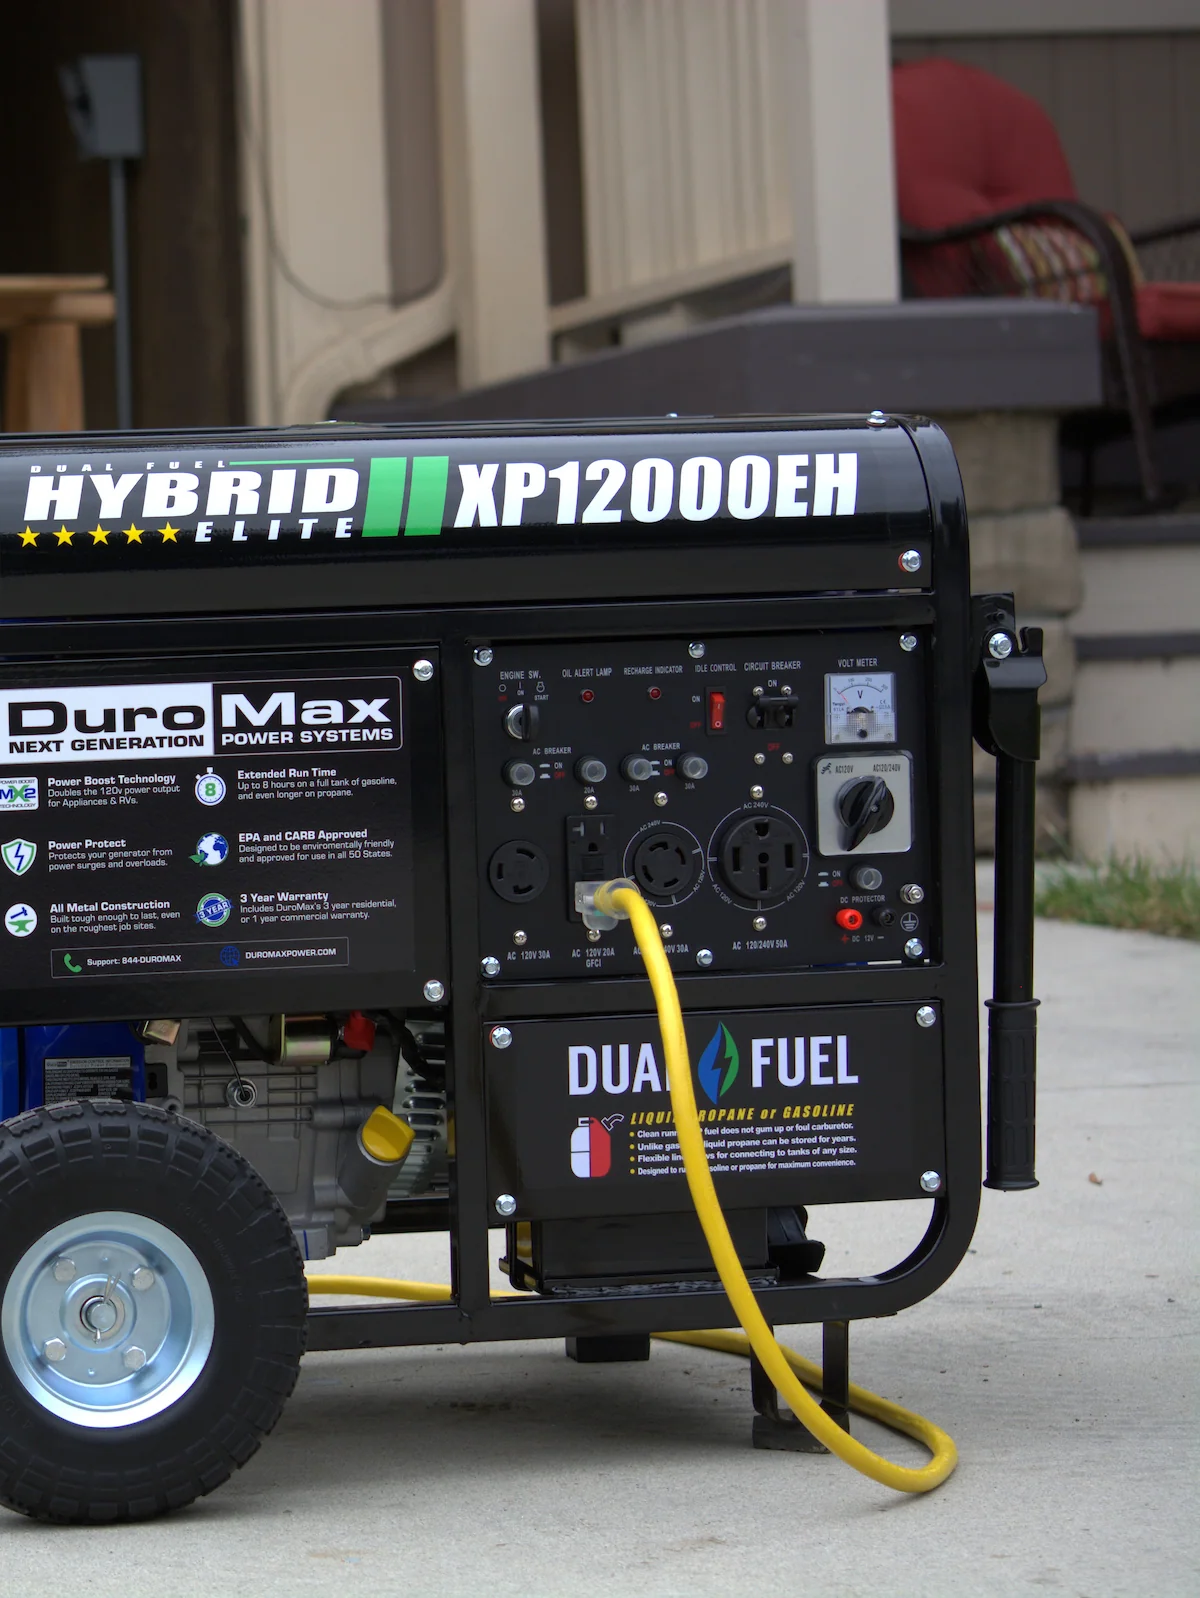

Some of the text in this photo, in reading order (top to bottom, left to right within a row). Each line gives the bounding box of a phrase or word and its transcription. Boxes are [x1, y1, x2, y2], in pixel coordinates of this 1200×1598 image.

[30, 460, 226, 473] DUAL FUEL
[23, 452, 858, 528] HYBRID XP12000EH
[194, 517, 354, 542] ELITE
[695, 663, 737, 673] IDLE CONTROL
[744, 661, 801, 671] CIRCUIT BREAKER
[838, 658, 878, 668] VOLT METER
[500, 670, 541, 680] ENGINE SW.
[562, 668, 612, 678] OIL ALERT LAMP
[624, 665, 683, 676] RECHARGE INDICATOR
[768, 680, 777, 688] ON
[8, 728, 393, 754] NEXT GENERATION POWER SYSTEMS
[544, 747, 571, 755] BREAKER
[237, 768, 336, 779] Extended Run Time
[48, 774, 176, 787] Power Boost Technology
[237, 782, 250, 791] Up
[262, 780, 269, 789] 8
[316, 779, 329, 787] full
[331, 778, 350, 786] tank
[351, 777, 359, 786] of
[48, 788, 82, 797] Doubles
[124, 787, 151, 796] power
[152, 785, 180, 794] output
[205, 783, 216, 796] 8
[238, 792, 253, 800] and
[277, 791, 303, 800] longer
[48, 796, 138, 808] for Appliances & RVs.
[239, 829, 367, 842] EPA and CARB Approved
[48, 839, 126, 850] Power Protect
[238, 844, 277, 854] Designed
[364, 839, 394, 849] friendly
[48, 848, 173, 861] Protects your generator from
[239, 854, 254, 863] and
[256, 853, 295, 863] approved
[297, 852, 309, 860] for
[337, 851, 346, 859] all
[349, 850, 361, 858] 50
[48, 863, 75, 872] power
[77, 862, 106, 871] surges
[108, 860, 123, 868] and
[240, 892, 329, 904] 3 Year Warranty
[852, 894, 885, 903] PROTECTOR
[50, 900, 170, 913] All Metal Construction
[206, 902, 228, 914] YEAR
[240, 905, 274, 913] Includes
[323, 901, 329, 910] 3
[331, 903, 350, 911] year
[50, 915, 70, 923] Built
[71, 914, 96, 924] tough
[98, 913, 128, 922] enough
[260, 916, 278, 924] year
[280, 912, 328, 921] commercial
[63, 925, 77, 933] the
[79, 924, 117, 933] roughest
[119, 922, 131, 932] job
[732, 939, 788, 950] AC 120/240V 50A
[245, 948, 336, 959] DUROMAXPOWER.COM
[507, 950, 551, 960] AC 120V 30A
[572, 948, 615, 957] AC 120V 20A
[87, 955, 182, 967] Support: 844-DUROMAX
[586, 959, 602, 968] GFCI
[752, 1035, 859, 1088] FUEL
[630, 1104, 854, 1125] LIQUI ROPANE or GASOLINE
[637, 1143, 664, 1151] Unlike
[727, 1140, 760, 1148] propane
[791, 1136, 817, 1144] stored
